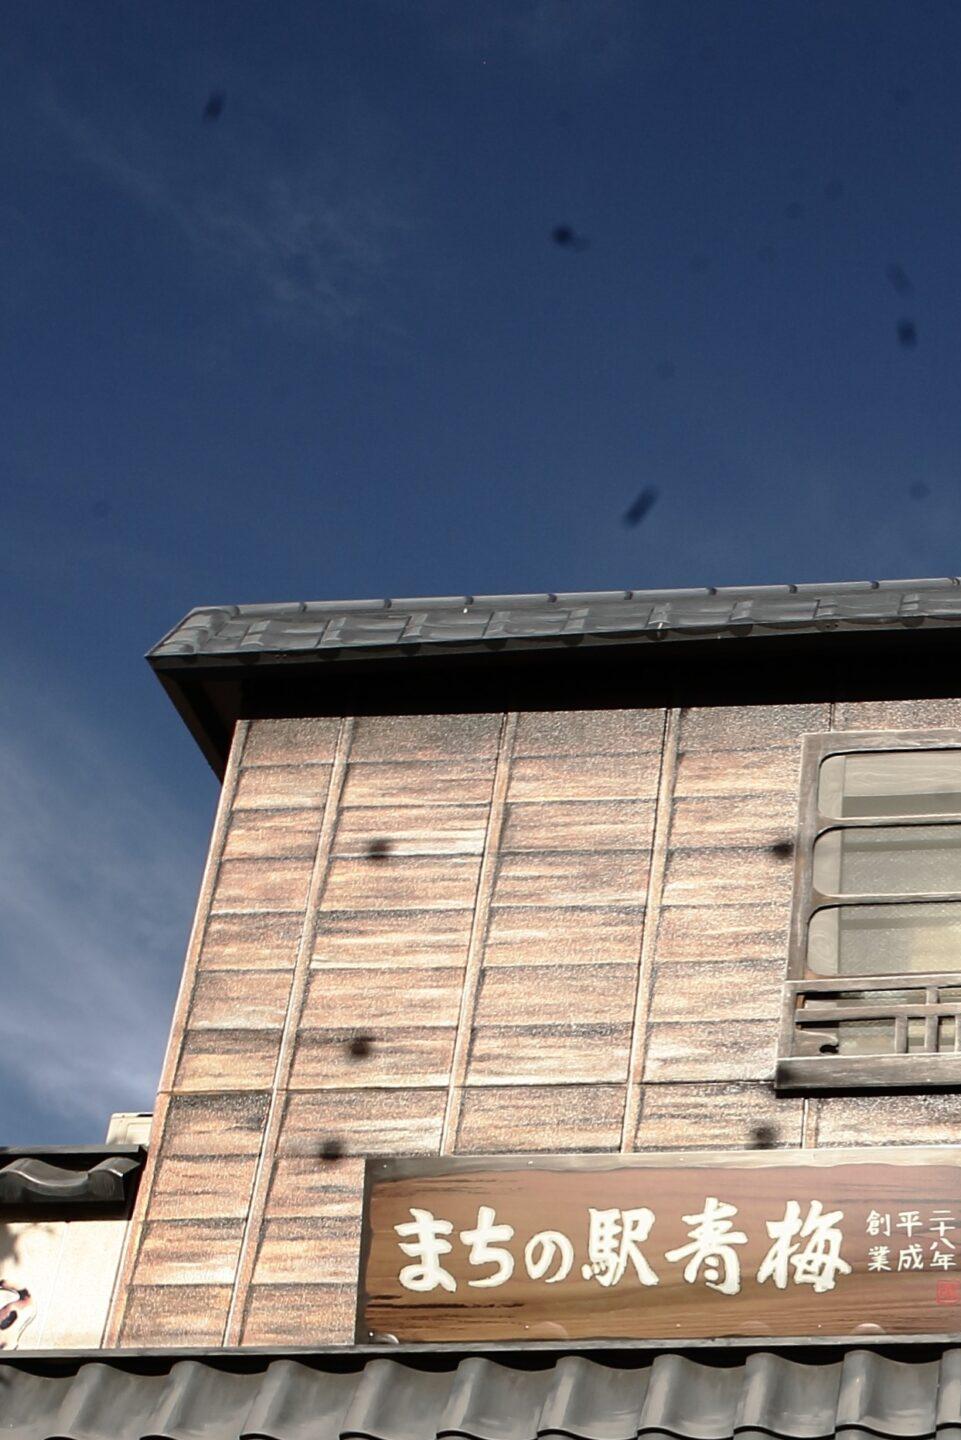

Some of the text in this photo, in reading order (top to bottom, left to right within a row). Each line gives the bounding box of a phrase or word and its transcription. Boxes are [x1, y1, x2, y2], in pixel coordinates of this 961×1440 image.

[395, 1197, 852, 1294] まちの駅青梅
[866, 1209, 892, 1272] 創業
[896, 1210, 924, 1272] 平成
[929, 1210, 957, 1271] 二十八年
